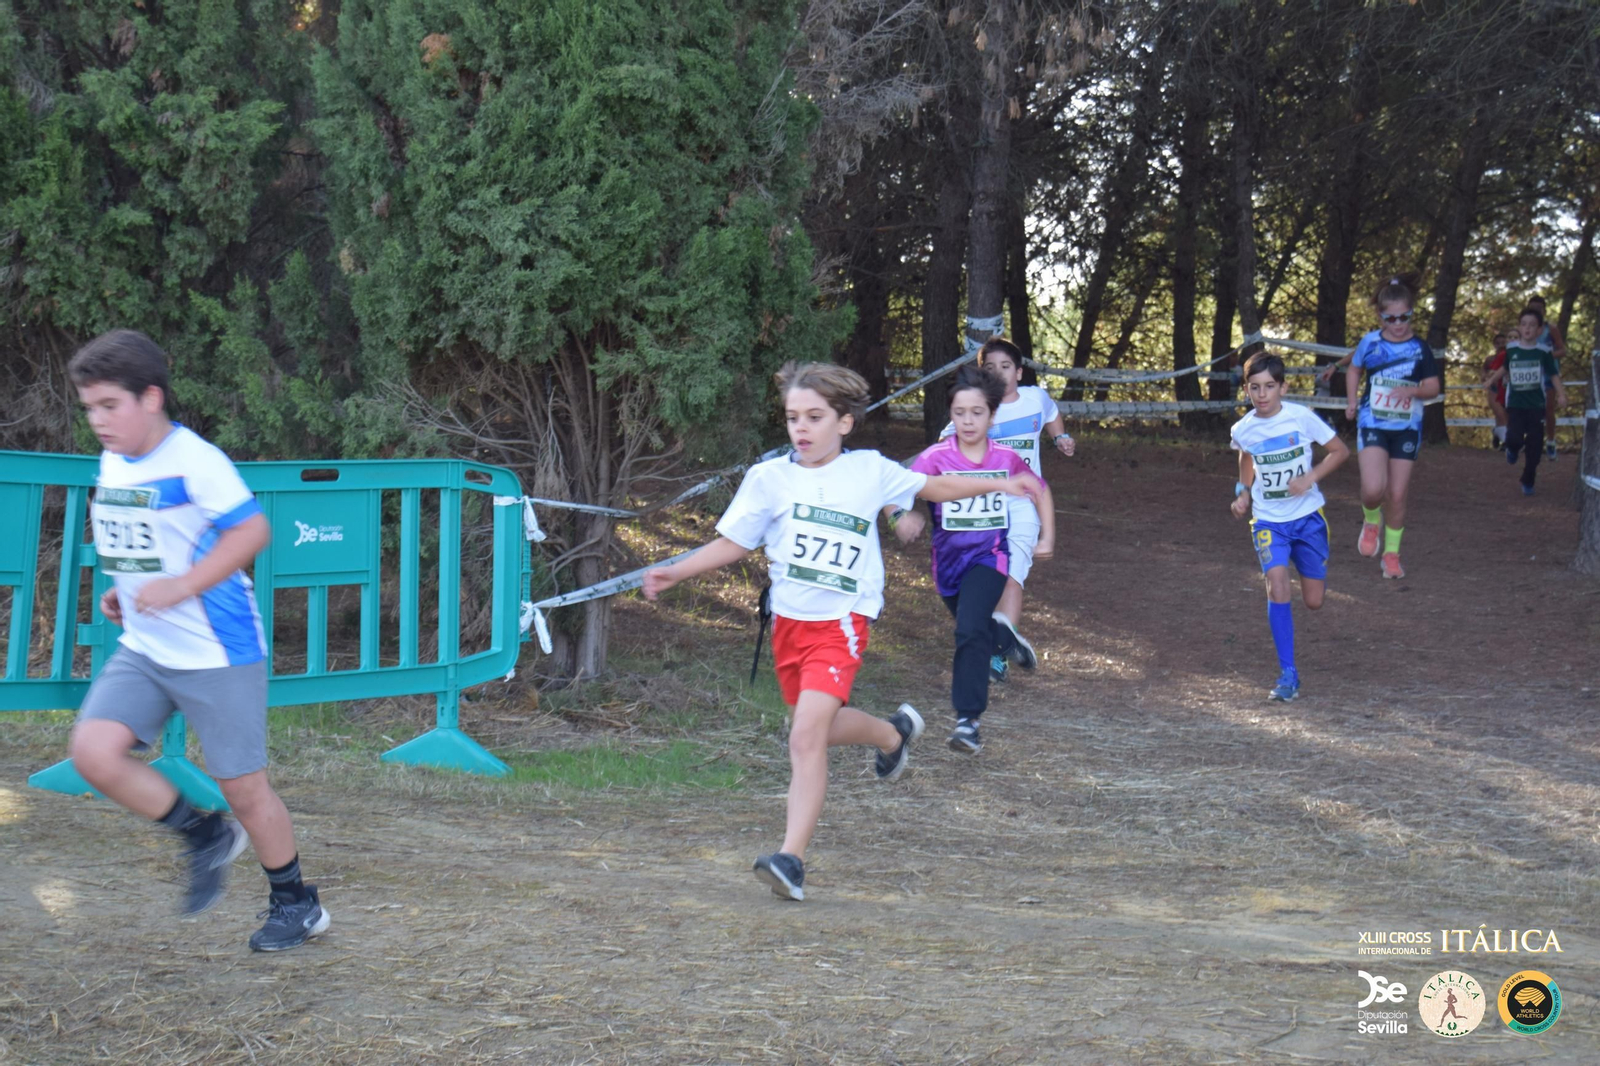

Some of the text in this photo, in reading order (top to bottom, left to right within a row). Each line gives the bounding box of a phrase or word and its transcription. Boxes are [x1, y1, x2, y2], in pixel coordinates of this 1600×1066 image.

[1512, 371, 1539, 383] 5805
[1375, 392, 1411, 410] 7178
[1261, 464, 1306, 488] 5724
[950, 493, 1002, 513] 5716
[319, 532, 343, 542] Sevilla
[793, 533, 861, 570] 5717
